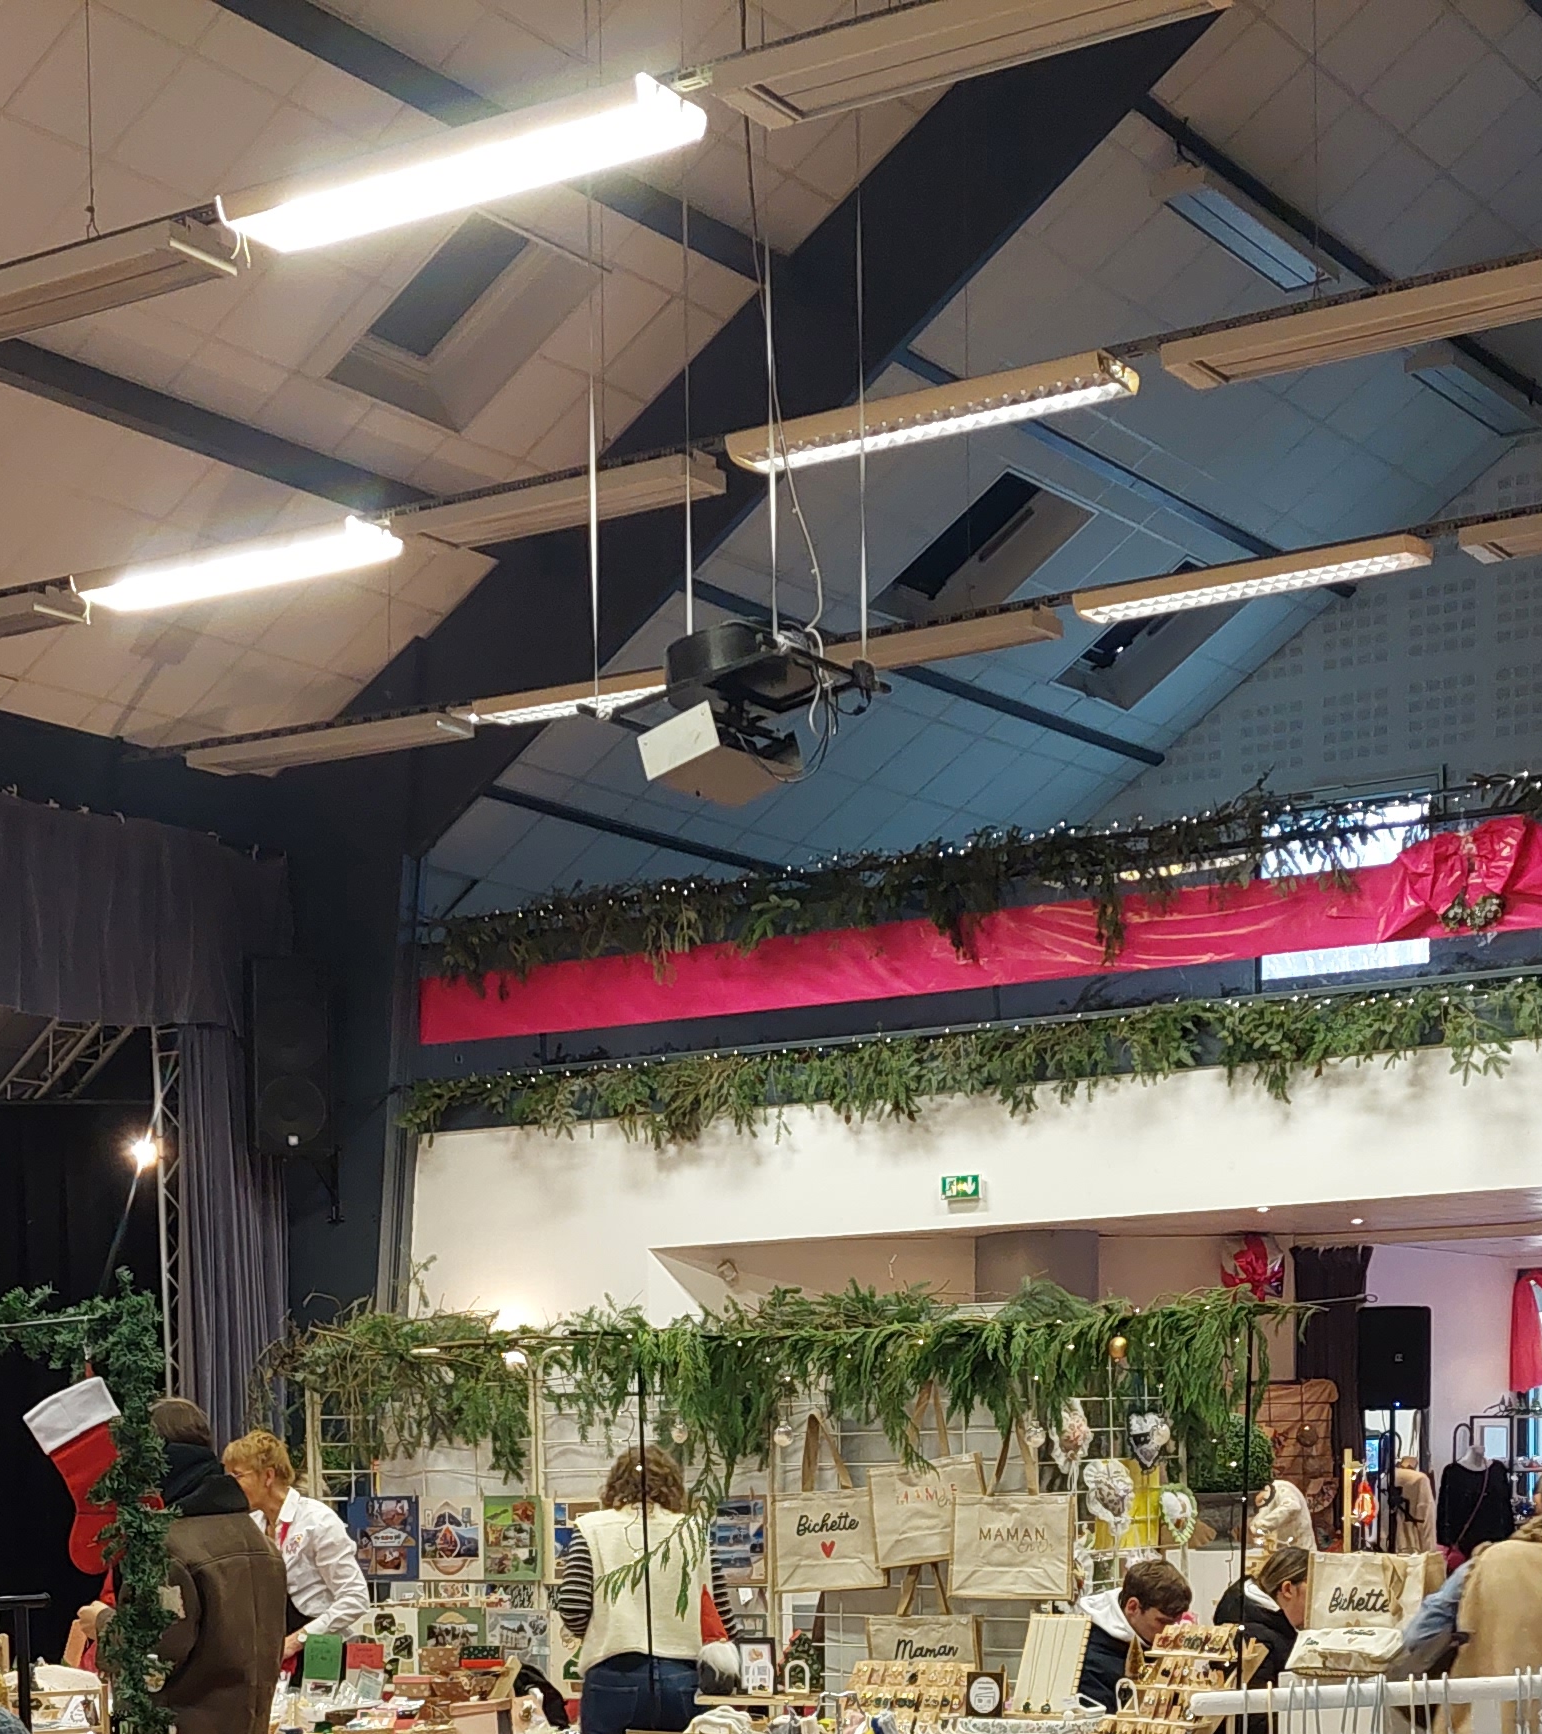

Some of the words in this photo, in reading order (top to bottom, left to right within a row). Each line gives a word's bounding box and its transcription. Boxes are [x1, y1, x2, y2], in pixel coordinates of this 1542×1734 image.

[796, 1511, 860, 1536] Bichette
[979, 1526, 1045, 1542] MAMAN
[1328, 1586, 1391, 1614] Bichette
[894, 1638, 959, 1661] Maman
